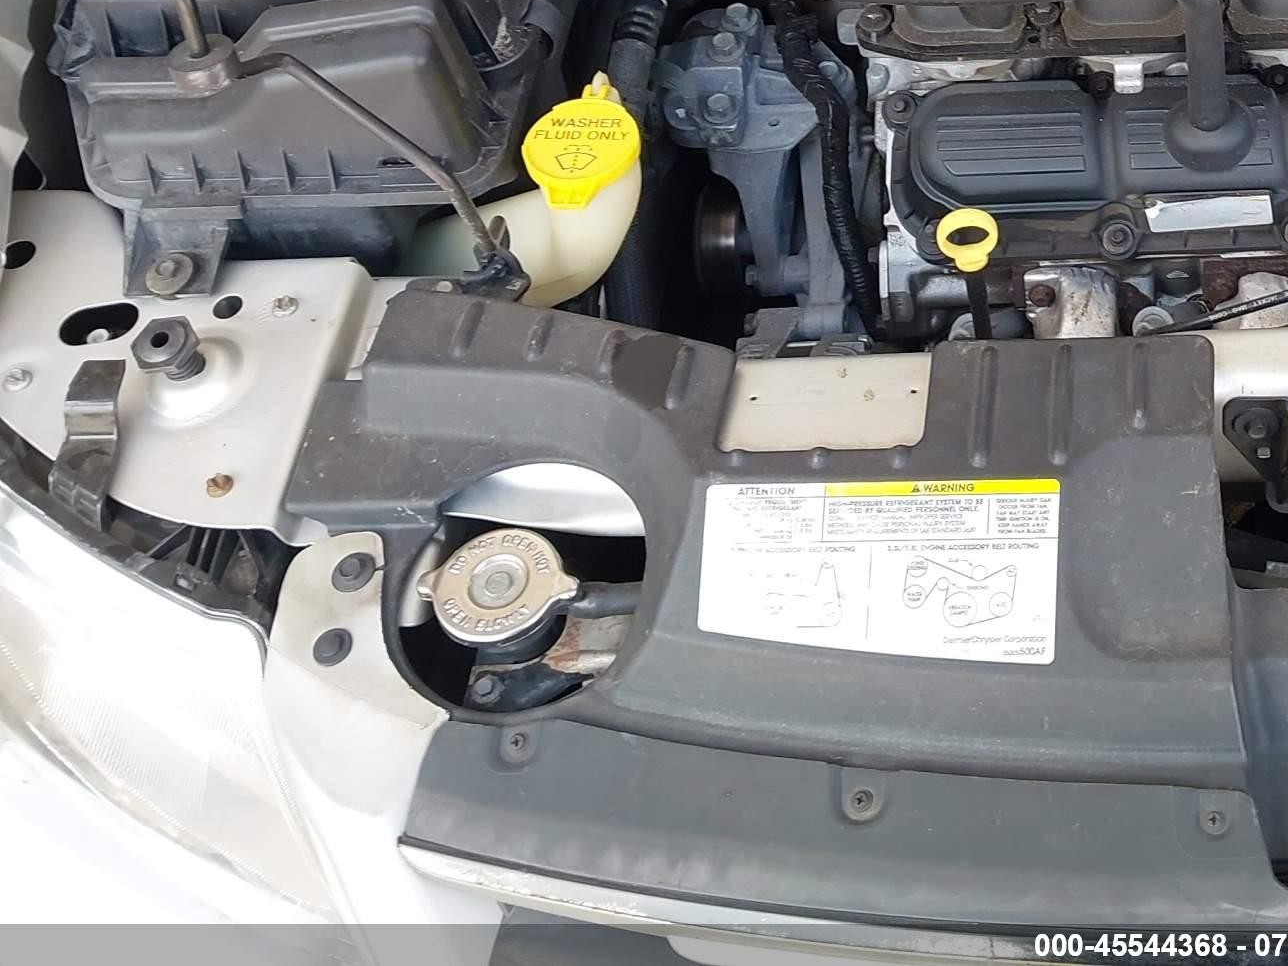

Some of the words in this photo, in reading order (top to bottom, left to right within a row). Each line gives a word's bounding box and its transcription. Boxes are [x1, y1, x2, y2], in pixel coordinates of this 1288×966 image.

[551, 117, 622, 128] WASHER
[533, 129, 582, 141] FLUID
[586, 130, 631, 141] ONLY
[738, 487, 796, 497] ATTENTION
[923, 482, 976, 494] WARNING
